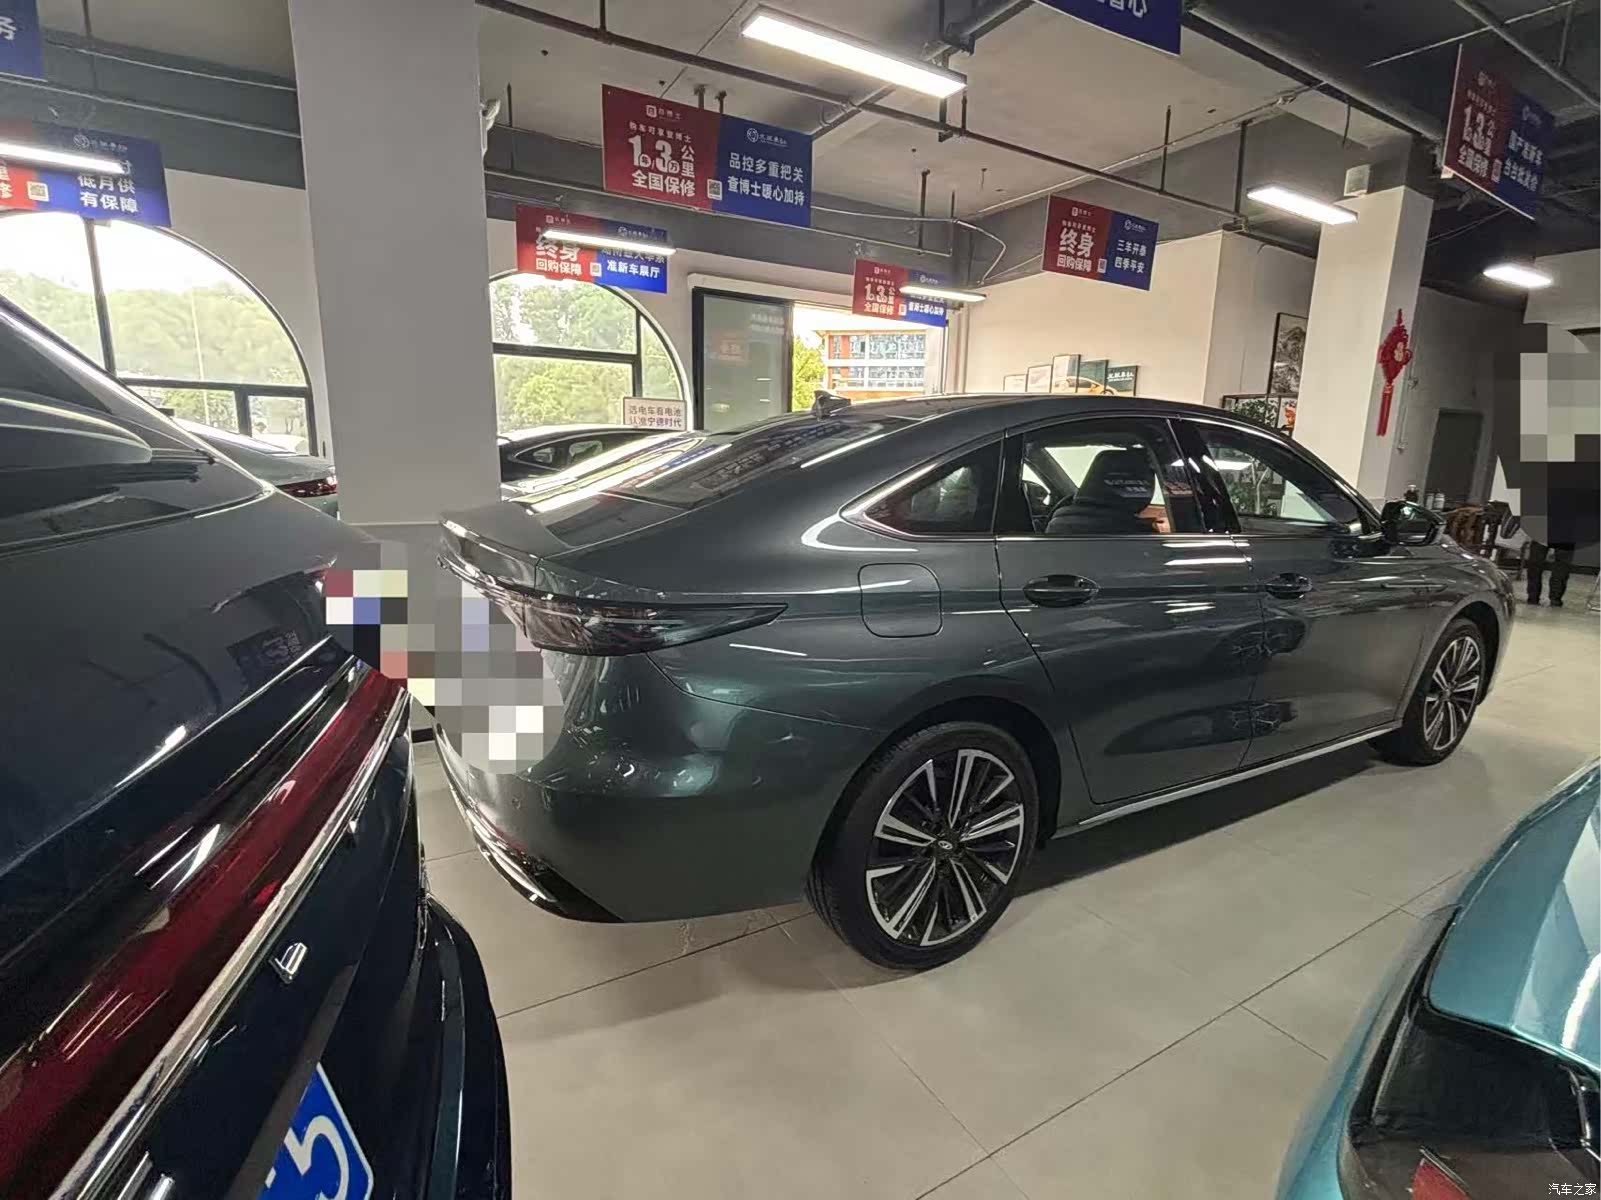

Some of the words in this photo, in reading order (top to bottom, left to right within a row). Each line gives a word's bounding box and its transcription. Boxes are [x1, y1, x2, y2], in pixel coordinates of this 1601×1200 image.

[729, 152, 804, 183] 品控多重把关
[77, 175, 135, 194] 低月供
[631, 170, 695, 197] 全国保修
[728, 175, 805, 206] 查博士暖心加持
[80, 191, 138, 213] 有保障
[1059, 228, 1094, 257] 终身
[536, 258, 582, 276] 回购保障
[607, 259, 660, 279] 准新车展厅
[1057, 254, 1092, 272] 回购保障
[1115, 256, 1145, 273] 四季平安
